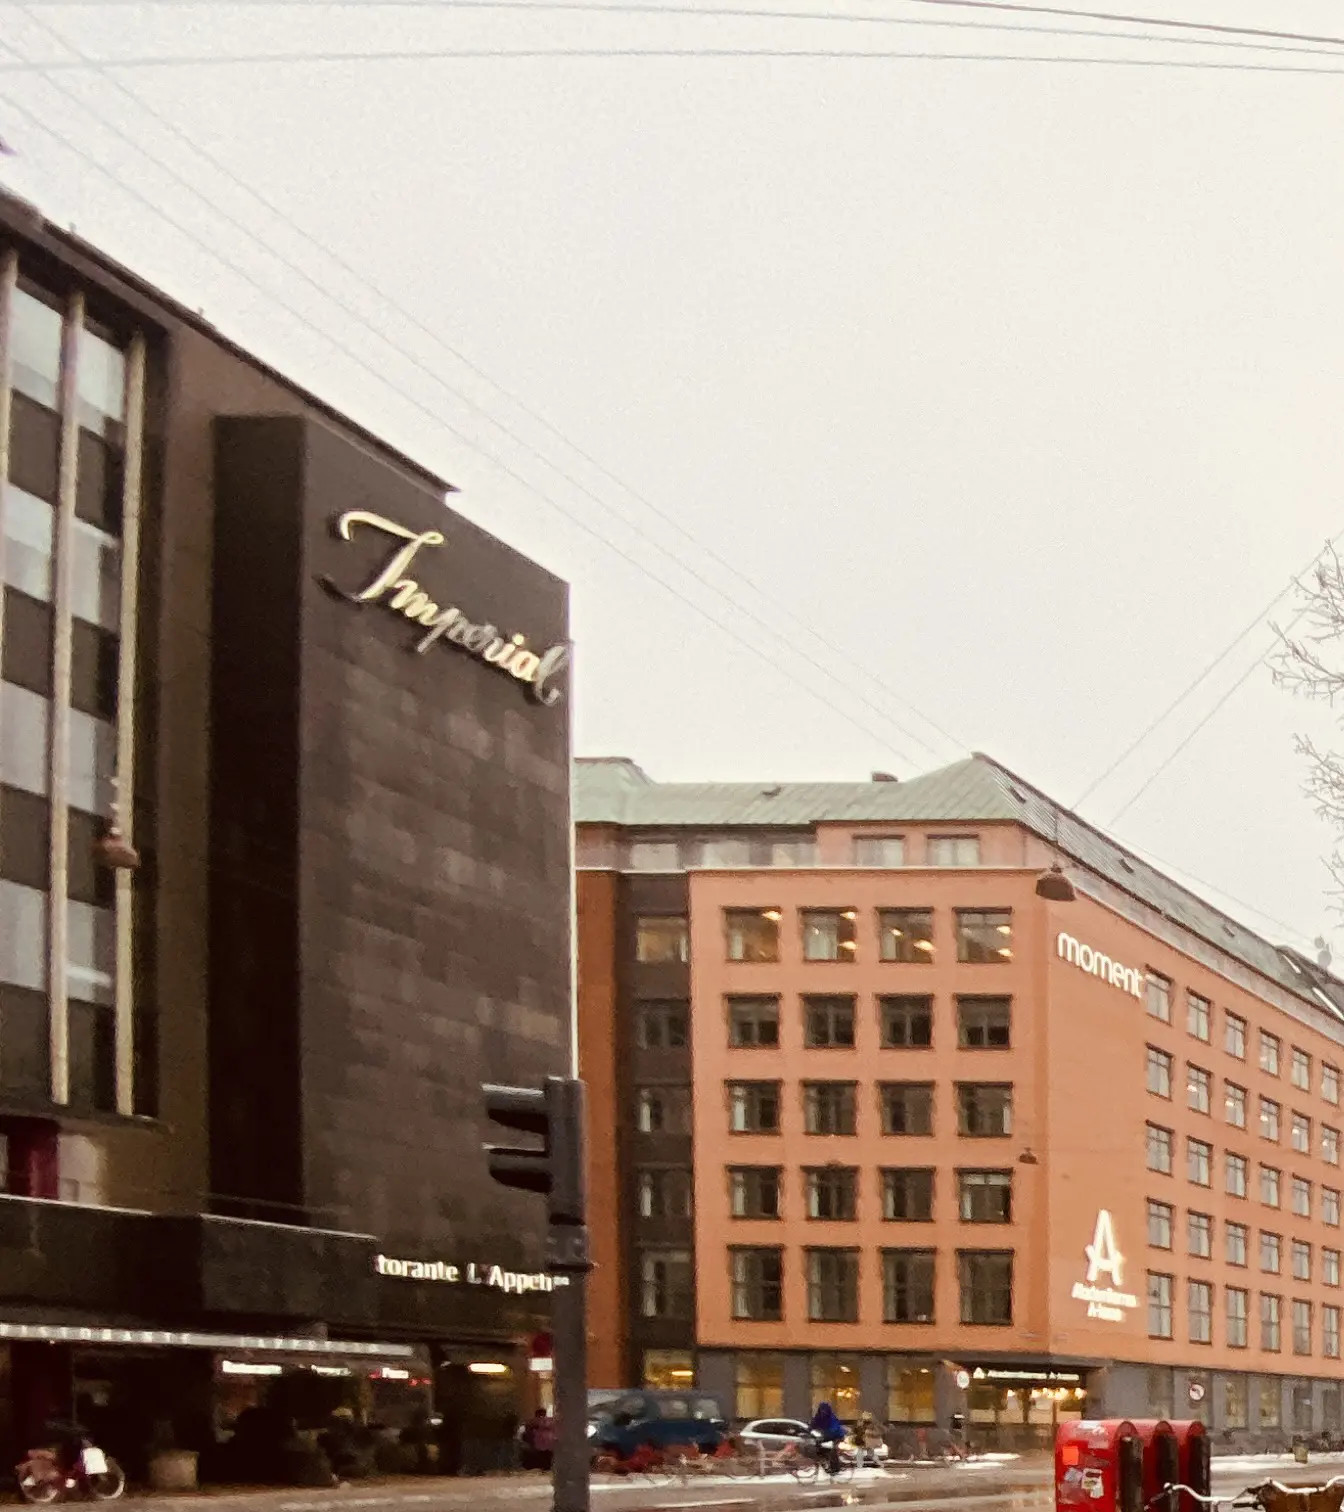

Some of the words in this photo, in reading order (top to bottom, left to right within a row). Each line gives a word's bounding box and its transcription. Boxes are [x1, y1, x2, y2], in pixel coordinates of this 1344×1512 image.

[322, 510, 570, 706] Imperial
[1058, 932, 1143, 998] moment
[374, 1254, 460, 1282] torante
